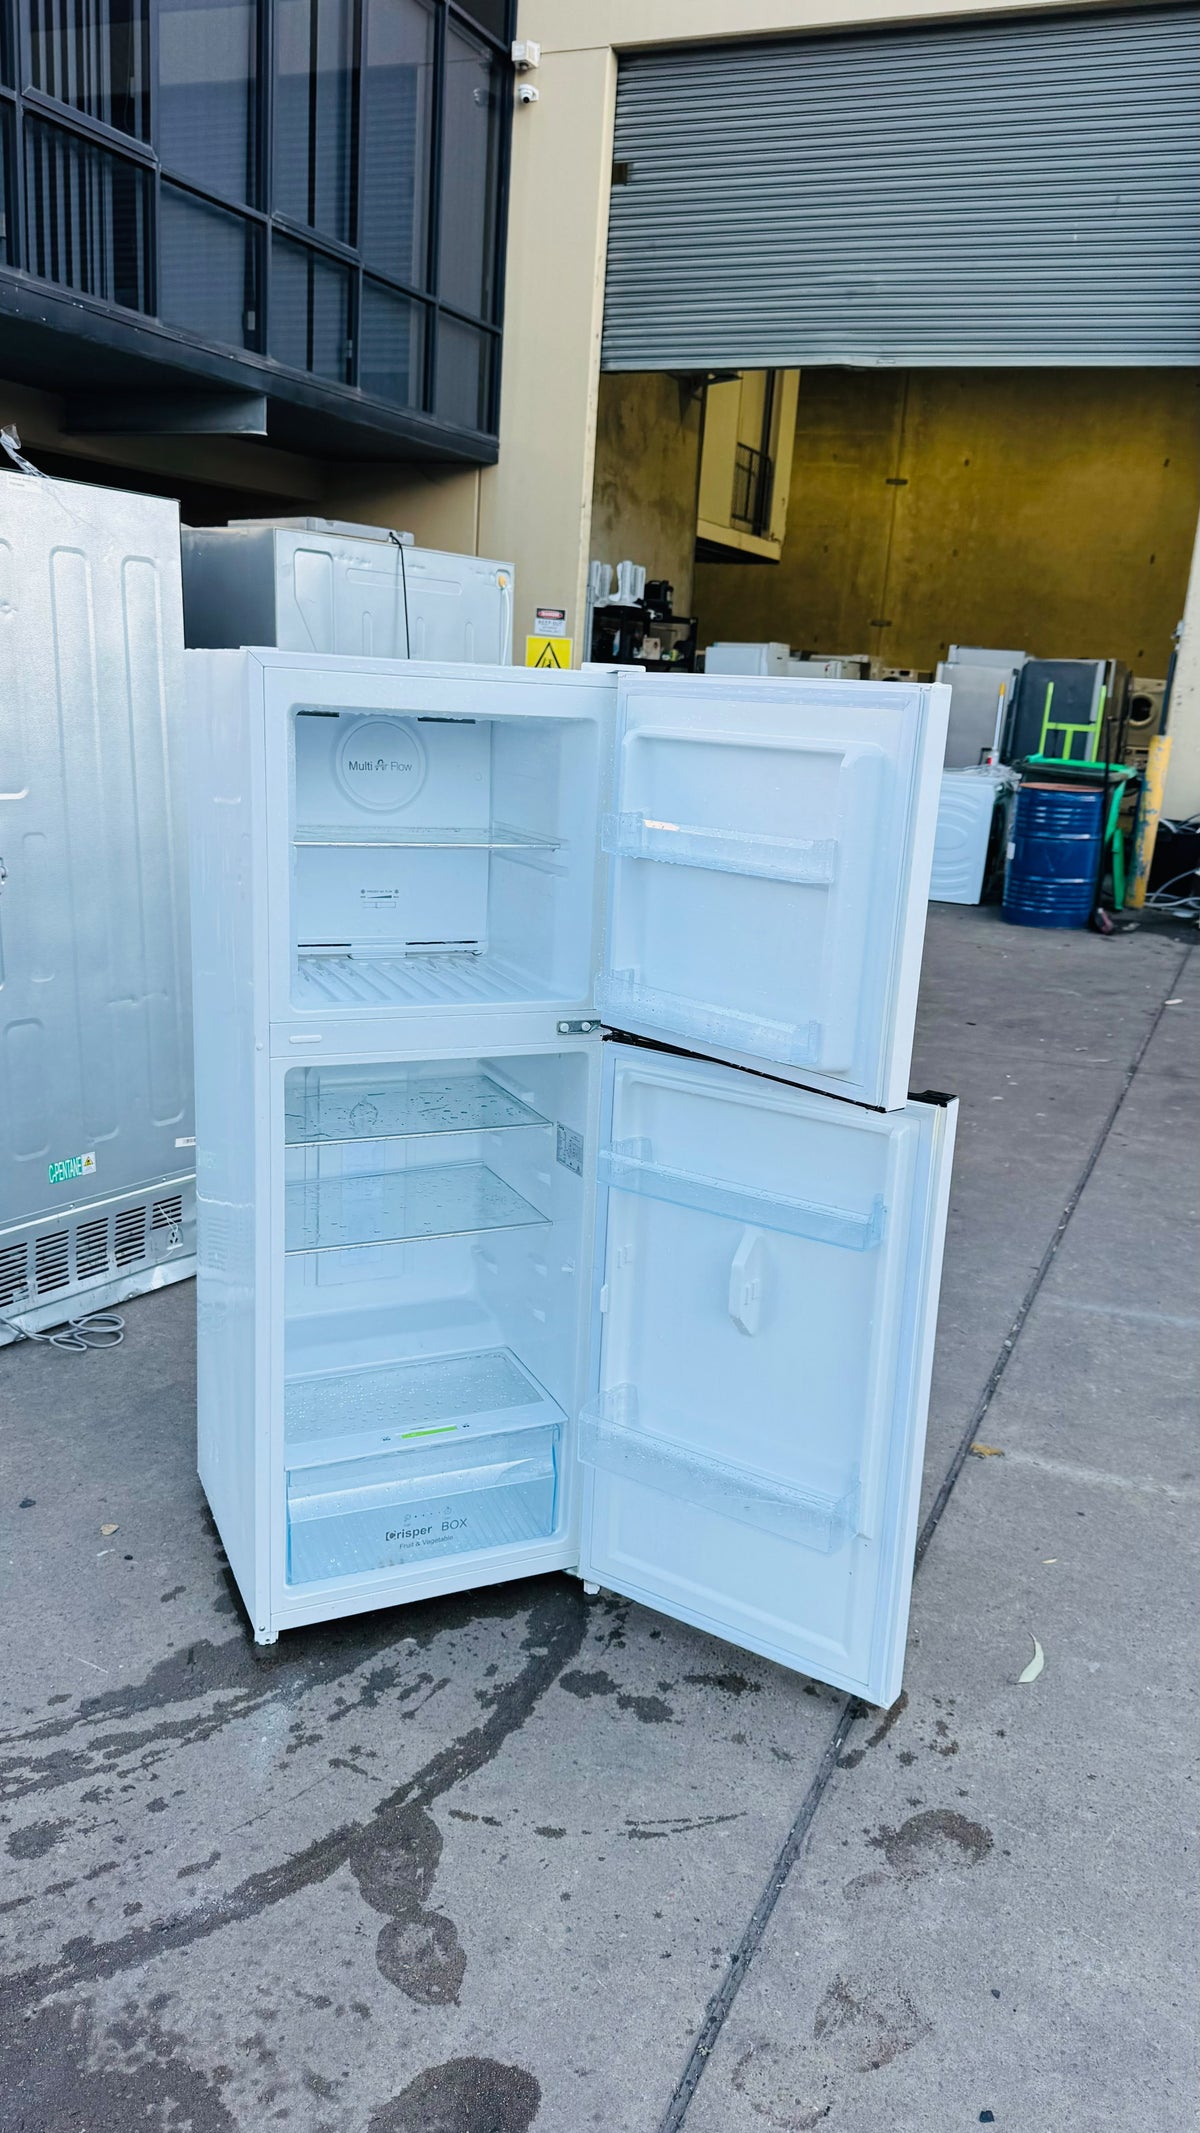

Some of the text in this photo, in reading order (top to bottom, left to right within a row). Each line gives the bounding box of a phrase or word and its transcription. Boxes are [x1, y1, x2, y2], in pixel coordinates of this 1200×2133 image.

[348, 760, 373, 771] Multi
[390, 761, 412, 772] Flow
[441, 1518, 467, 1531] BOX
[400, 1541, 414, 1550] Fruit
[422, 1535, 453, 1546] Vegetable
